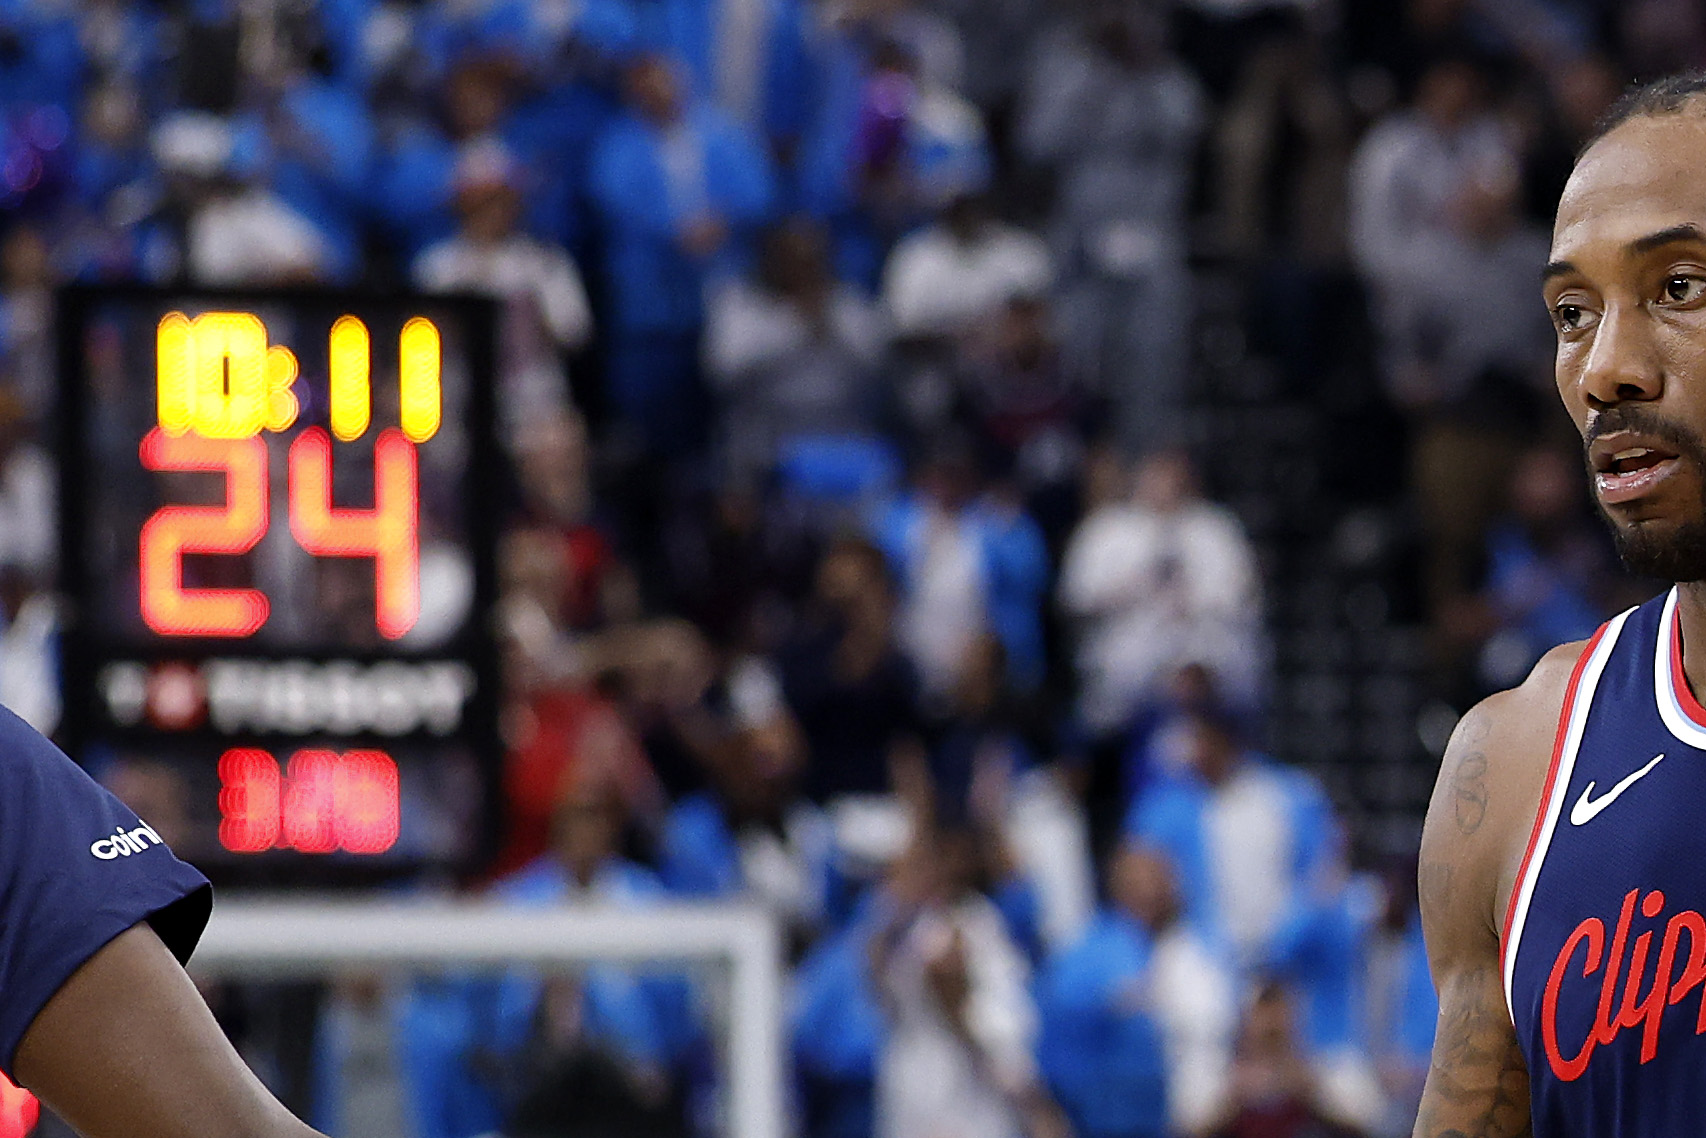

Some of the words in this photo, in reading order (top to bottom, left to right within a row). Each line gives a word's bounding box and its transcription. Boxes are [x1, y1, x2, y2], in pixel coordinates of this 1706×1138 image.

[157, 311, 441, 443] 10:11
[139, 425, 420, 640] 24
[90, 819, 164, 860] coin
